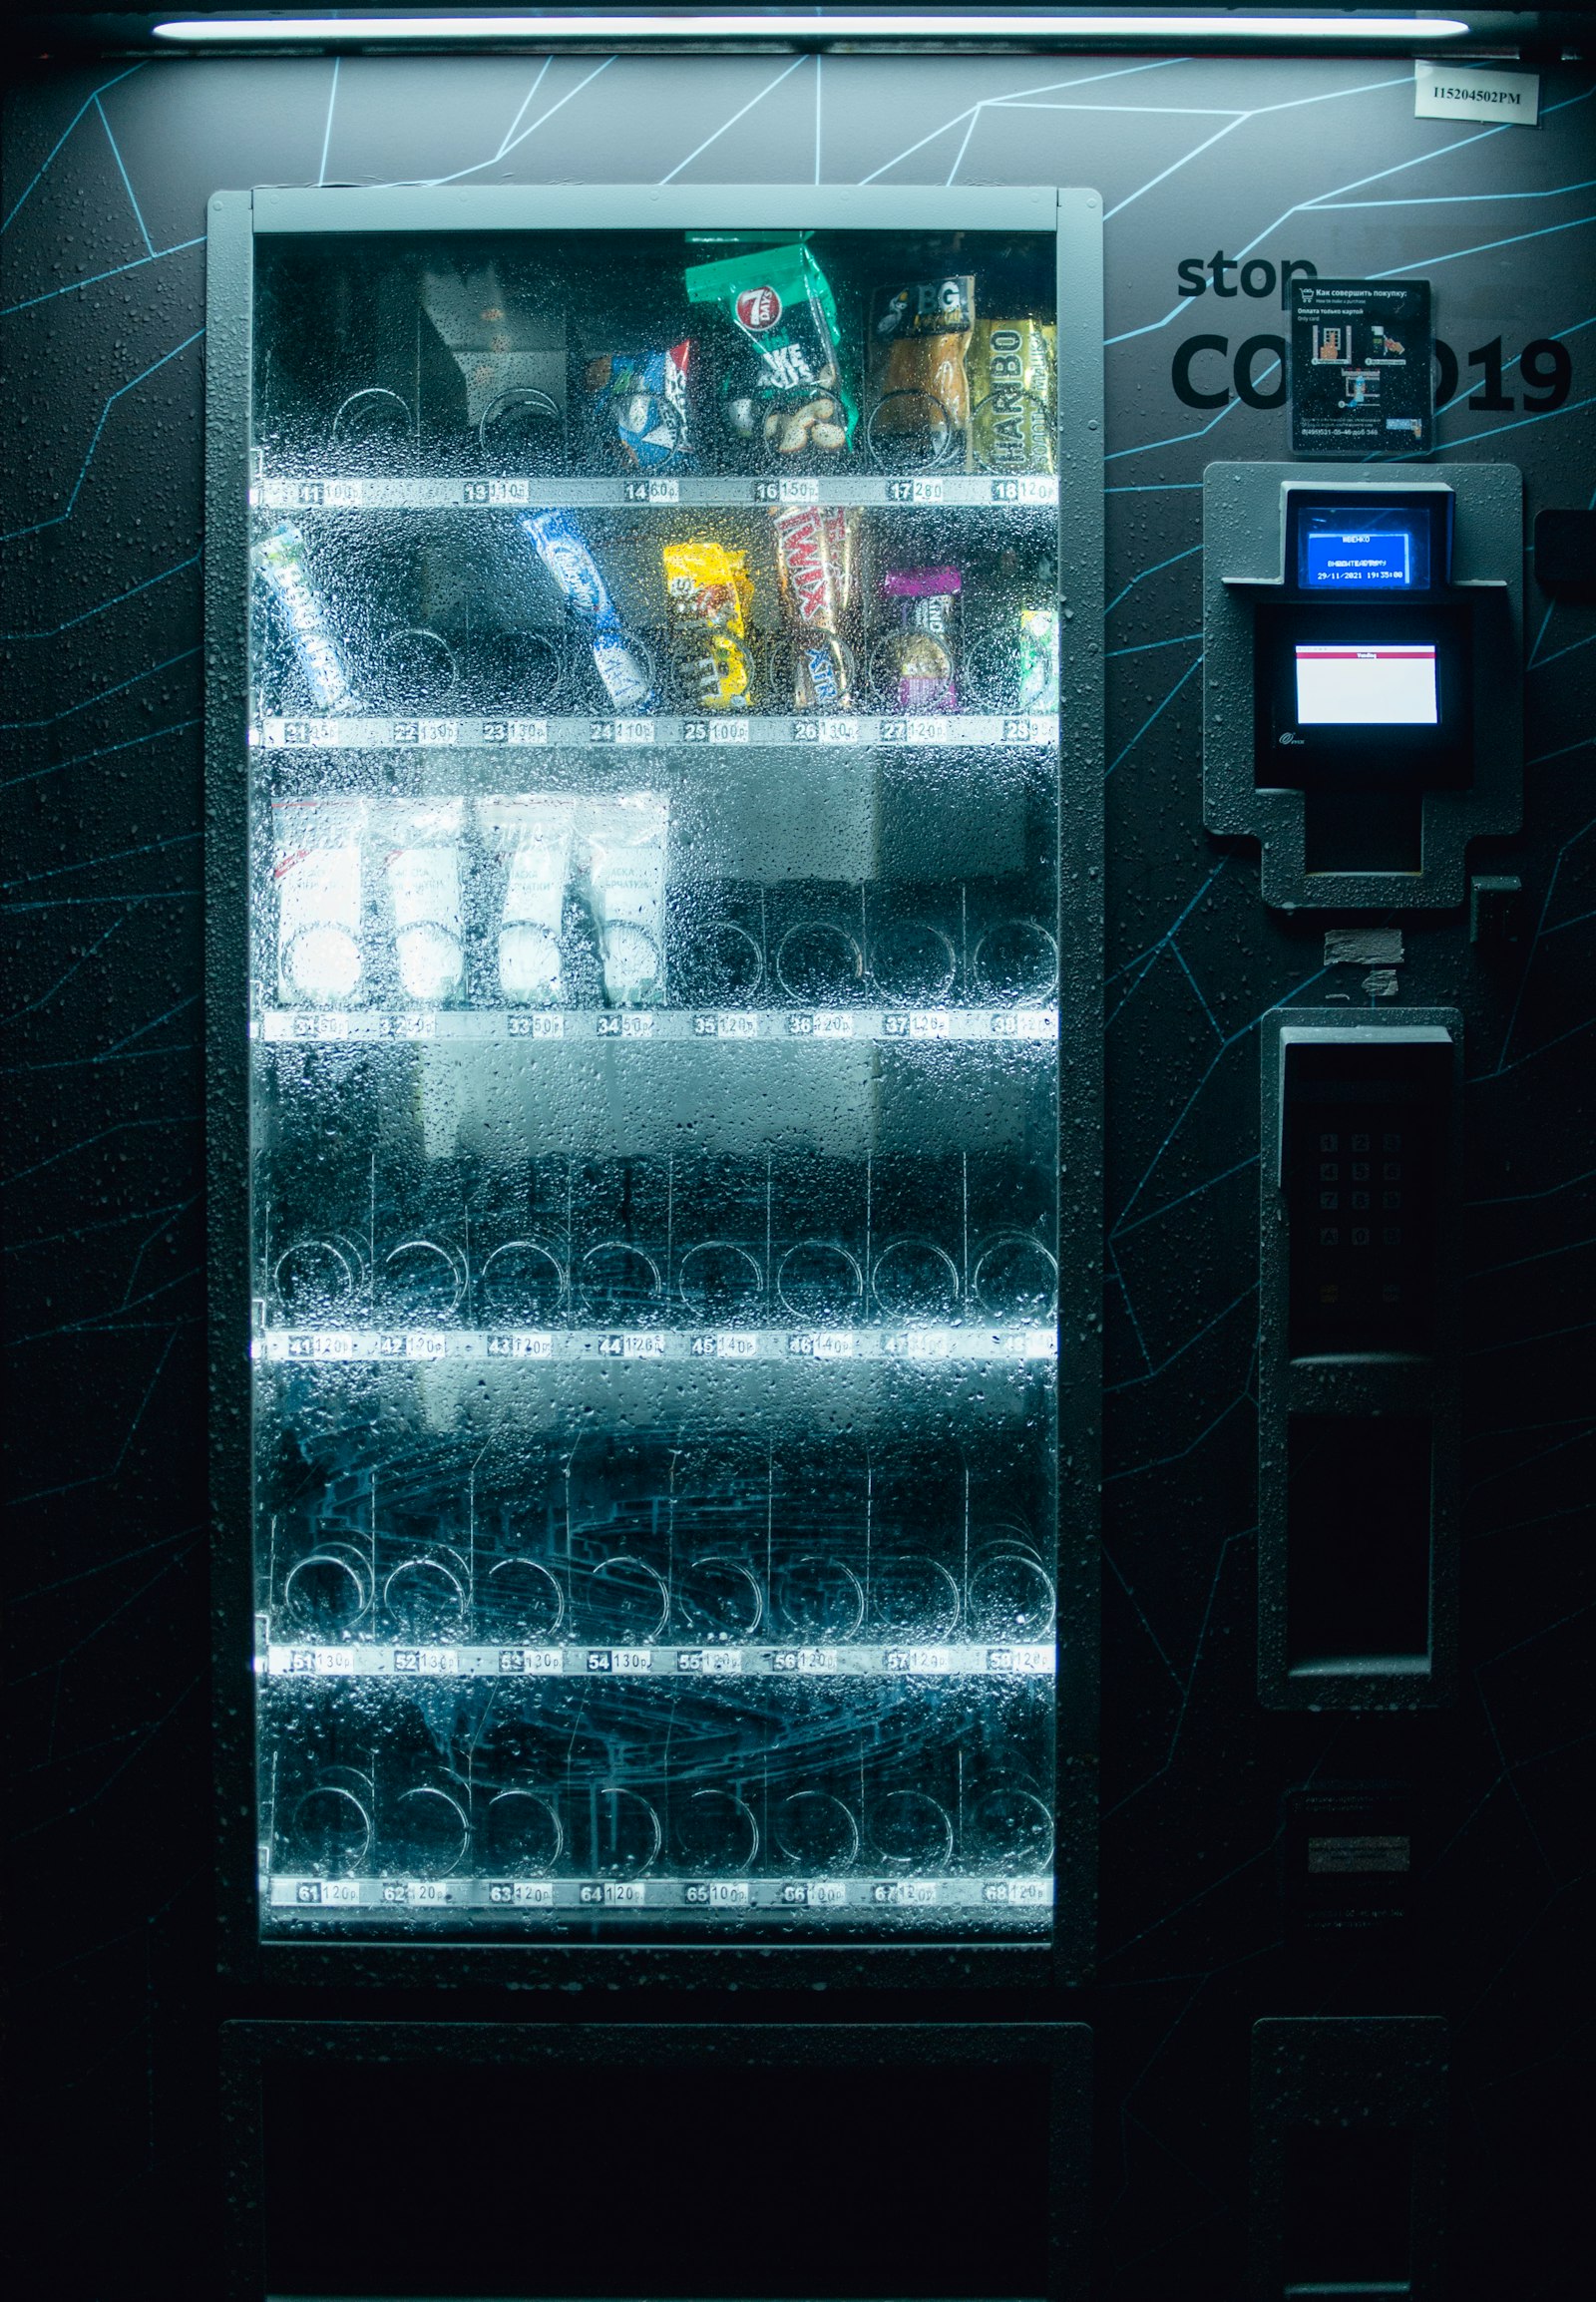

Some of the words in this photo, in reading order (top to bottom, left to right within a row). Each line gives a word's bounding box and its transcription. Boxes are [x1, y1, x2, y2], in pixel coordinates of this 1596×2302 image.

[1433, 87, 1521, 105] I15204502PM
[1332, 289, 1373, 298] совершить
[1374, 289, 1407, 299] покупку:
[743, 288, 765, 326] 7
[761, 290, 774, 322] DAYS
[626, 485, 646, 500] 14
[758, 484, 778, 499] 16
[892, 484, 912, 499] 17
[997, 484, 1017, 499] 18
[1317, 572, 1363, 580] 29/11/2021
[1367, 571, 1403, 579] 19:35:00
[395, 725, 416, 740] 22
[485, 725, 505, 740] 23
[592, 725, 612, 739] 24
[685, 725, 706, 739] 25
[796, 724, 816, 740] 26
[885, 723, 906, 738] 27
[1007, 723, 1028, 738] 28
[510, 1018, 530, 1034] 33
[598, 1018, 618, 1034] 34
[695, 1018, 716, 1033] 35
[887, 1018, 909, 1033] 37
[291, 1340, 311, 1353] 41
[382, 1339, 403, 1352] 42
[489, 1340, 510, 1354] 43
[600, 1339, 621, 1353] 44
[692, 1339, 713, 1353] 45
[294, 1655, 312, 1669] 51
[396, 1655, 417, 1669] 52
[590, 1655, 609, 1670] 54
[679, 1655, 700, 1669] 55
[773, 1655, 795, 1669] 56
[888, 1654, 909, 1668] 57
[991, 1654, 1011, 1668] 58
[299, 1886, 318, 1901] 61
[385, 1887, 405, 1901] 62
[492, 1888, 512, 1901] 63
[582, 1887, 601, 1901] 64
[687, 1888, 708, 1901] 65
[785, 1887, 805, 1901] 66
